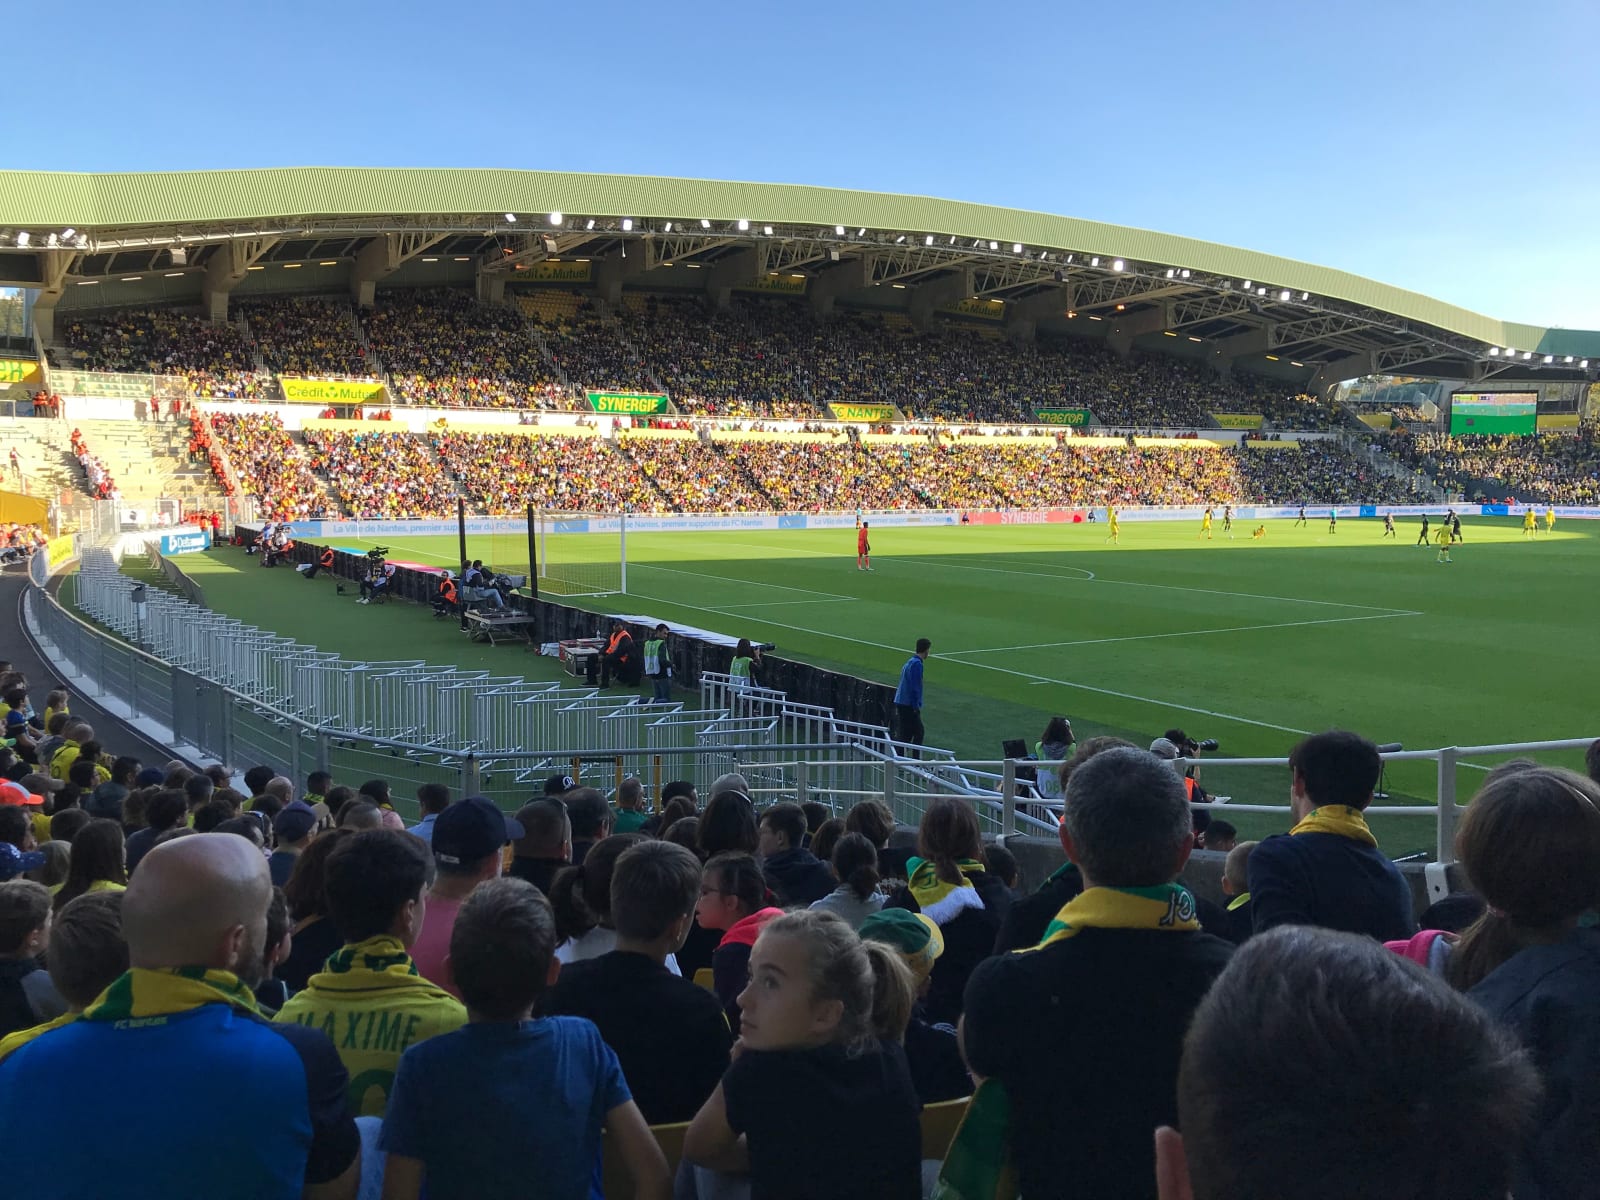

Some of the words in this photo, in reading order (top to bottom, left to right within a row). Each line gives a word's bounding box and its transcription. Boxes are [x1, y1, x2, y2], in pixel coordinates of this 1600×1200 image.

[553, 268, 588, 279] Mutuel
[340, 389, 379, 400] Mutuel
[598, 396, 659, 412] SYNERGIE
[847, 407, 893, 419] NANTES
[1001, 511, 1048, 524] SYNERGIE
